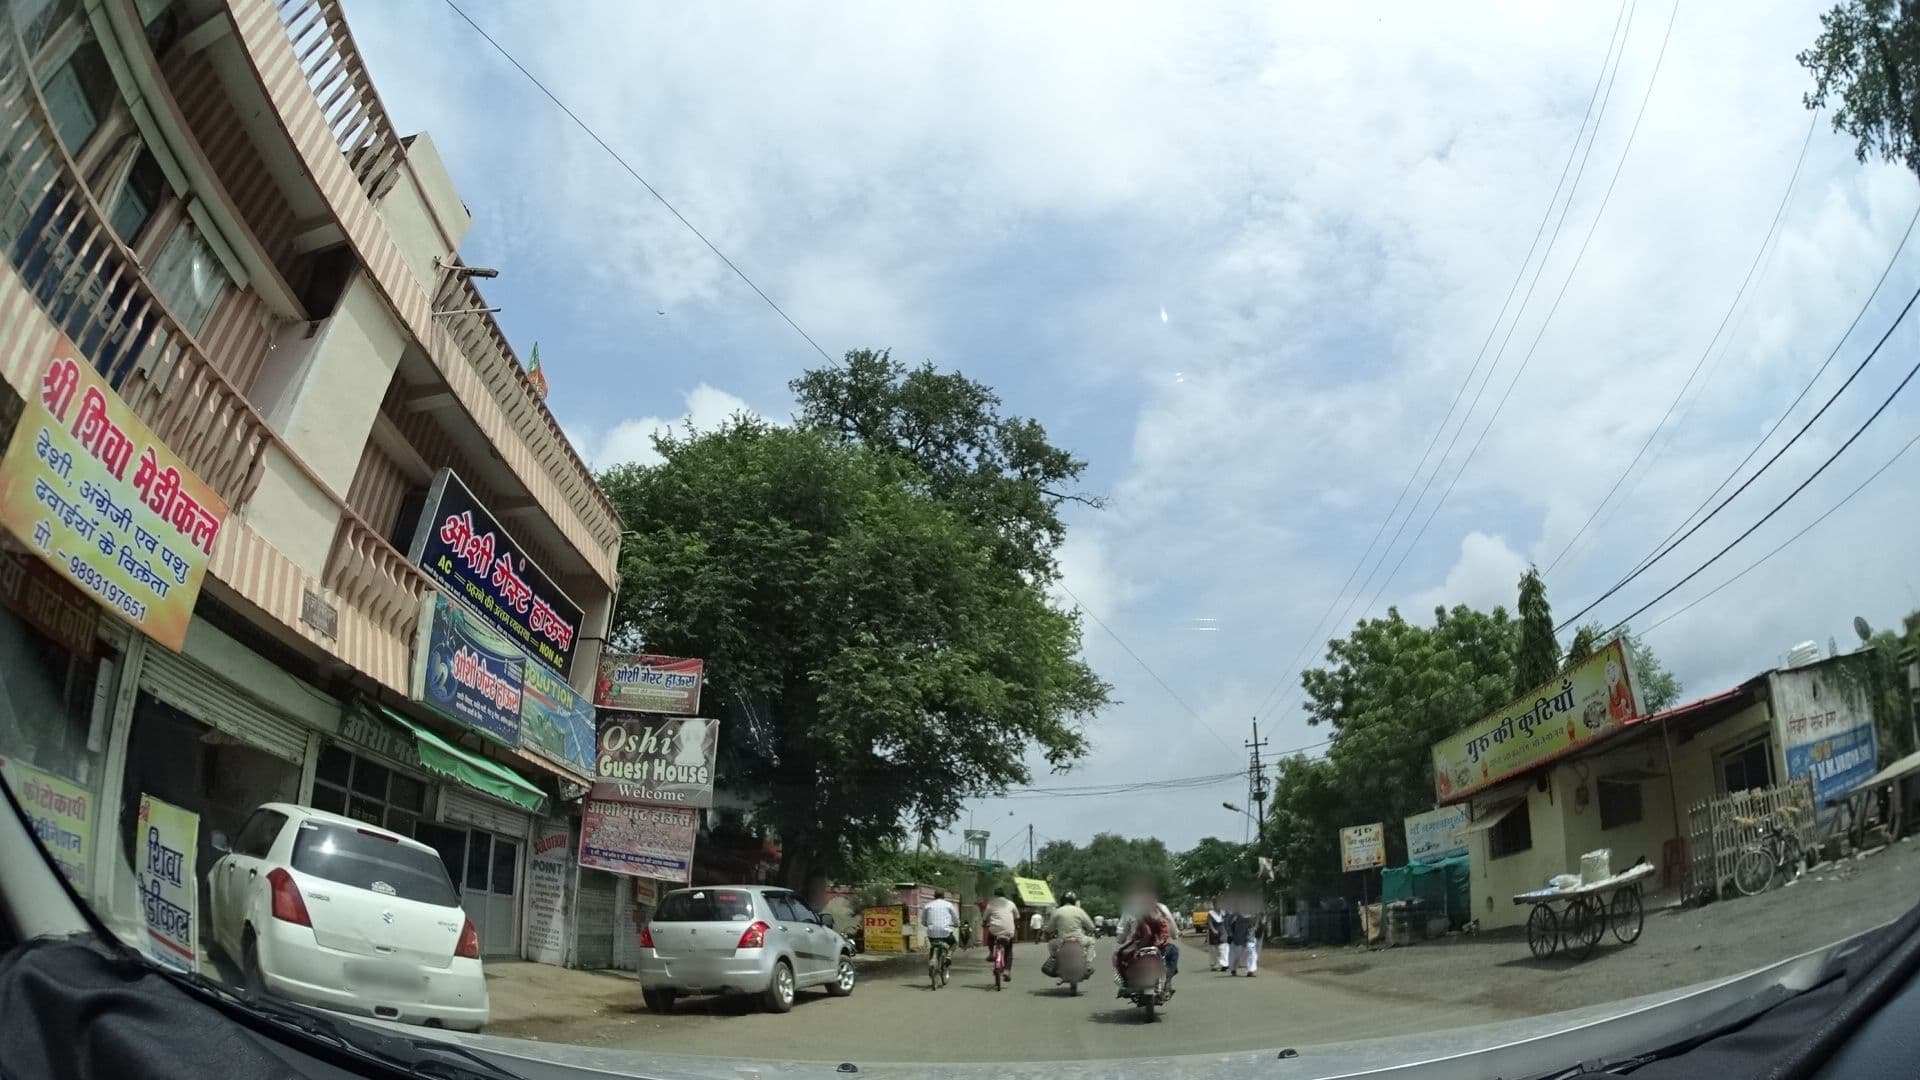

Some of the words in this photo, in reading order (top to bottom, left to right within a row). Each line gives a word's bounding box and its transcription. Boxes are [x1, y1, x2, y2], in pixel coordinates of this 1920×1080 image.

[44, 359, 79, 425] श्री
[71, 386, 134, 482] शिवा
[133, 444, 220, 556] मेडीकल
[79, 480, 133, 535] अंग्रेजी
[134, 521, 162, 555] एवं
[161, 546, 190, 584] पशु
[98, 531, 116, 556] के
[441, 511, 495, 578] ओशी
[69, 556, 147, 622] 9893197651
[437, 555, 453, 575] AC
[539, 641, 554, 661] NON
[553, 655, 564, 670] AC
[614, 664, 640, 684] ओशी
[641, 667, 663, 686] गेस्ट
[603, 725, 674, 755] Oshi
[1491, 717, 1515, 745] की
[600, 754, 648, 780] Guest
[652, 759, 708, 785] House
[618, 784, 686, 802] Welcome
[147, 826, 183, 886] शिवा
[534, 833, 567, 855] SOLUTION
[533, 859, 562, 875] POINT
